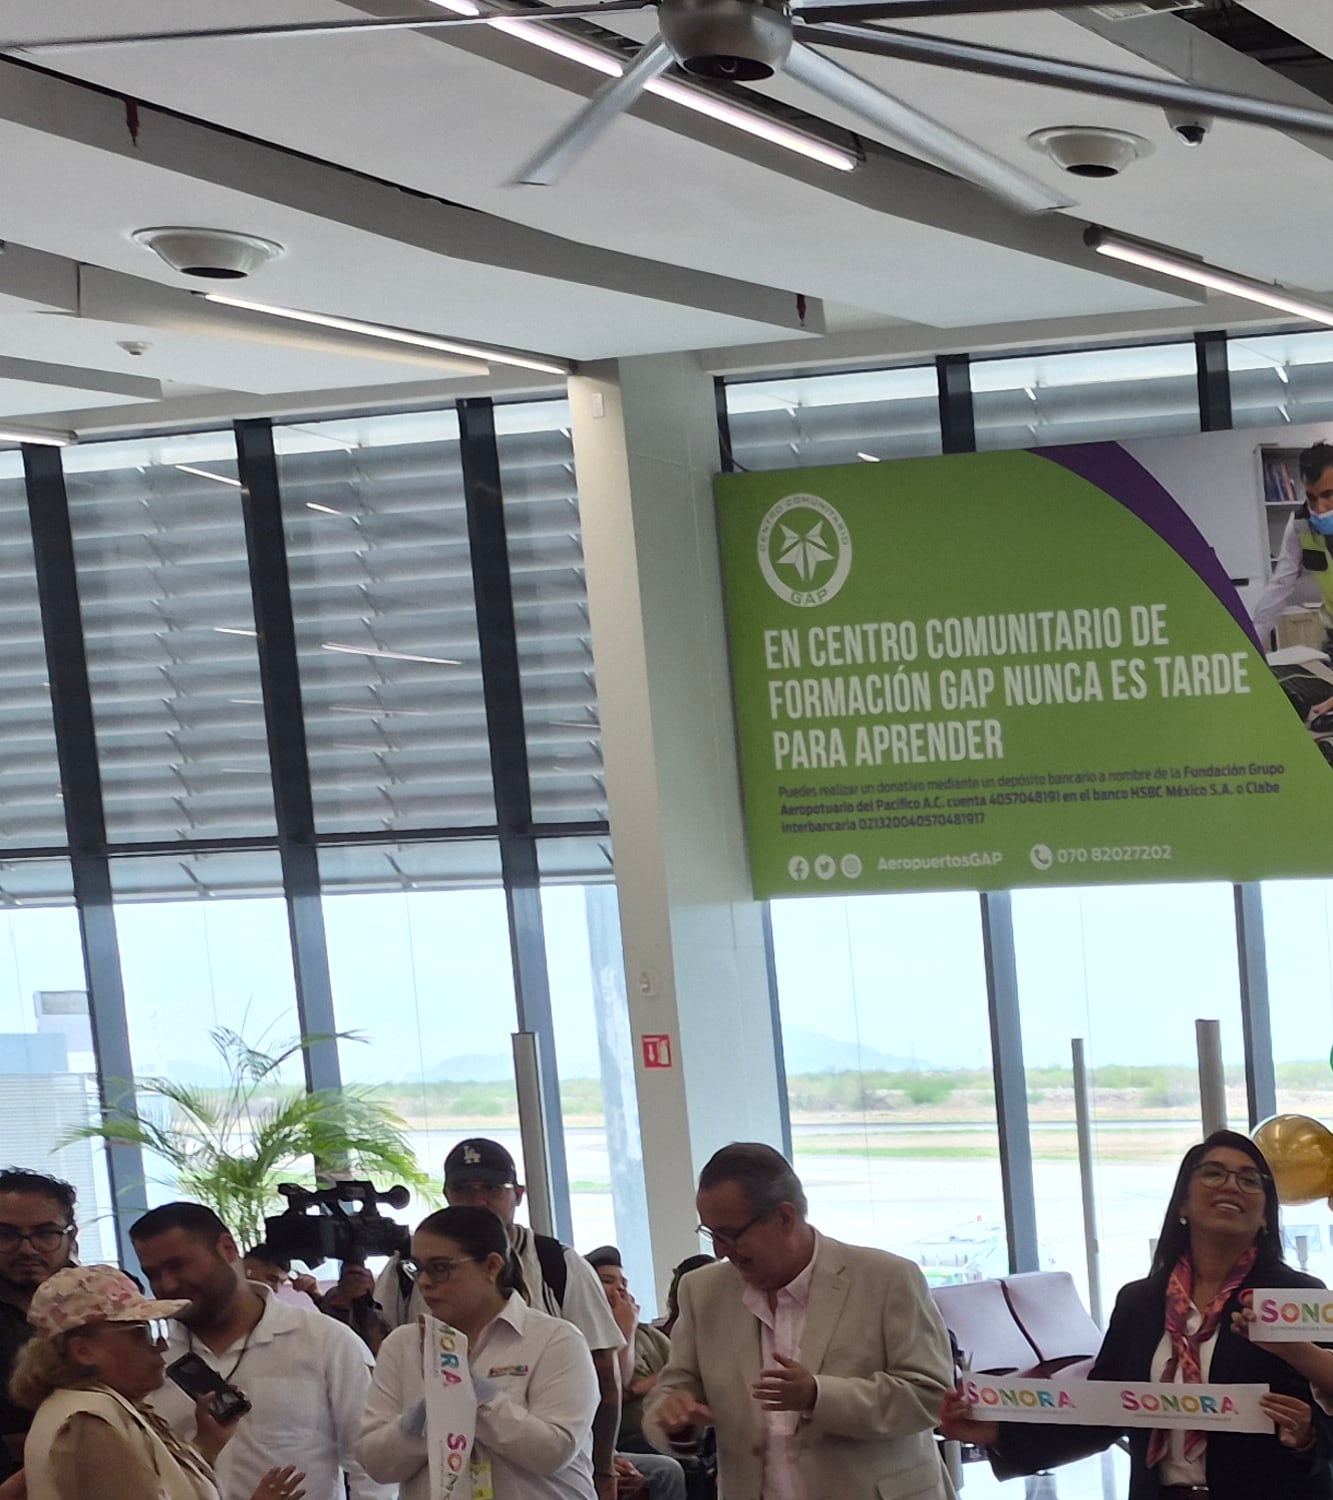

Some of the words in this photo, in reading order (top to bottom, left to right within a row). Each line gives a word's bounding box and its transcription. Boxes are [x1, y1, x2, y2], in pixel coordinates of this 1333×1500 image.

[790, 588, 829, 605] GAP
[763, 628, 801, 669] EN
[808, 620, 918, 668] CENTRO
[926, 606, 1122, 660] COMUNITARIO
[1130, 603, 1170, 647] DE
[768, 664, 932, 720] FORMACIÓN
[939, 667, 995, 711] GAP
[1003, 661, 1104, 707] NUNCA
[1110, 658, 1148, 700] ES
[1153, 652, 1250, 698] TARDE
[773, 727, 847, 770] PARA
[856, 719, 1004, 767] APRENDER
[779, 785, 817, 798] Puedes
[819, 784, 858, 796] realizar
[860, 783, 875, 795] un
[876, 780, 925, 793] donativo
[927, 776, 980, 790] mediante
[982, 777, 996, 788] un
[1047, 771, 1098, 785] bancario
[1108, 768, 1151, 781] nombre
[1154, 767, 1168, 780] de
[1171, 766, 1182, 778] la
[1184, 763, 1246, 778] Fundación
[1249, 762, 1285, 777] Grupo
[856, 800, 874, 812] del
[923, 797, 945, 809] A.C.
[947, 796, 987, 808] cuenta
[1063, 791, 1078, 803] en
[1080, 789, 1090, 802] el
[1092, 788, 1129, 801] banco
[1130, 784, 1164, 800] HSBC
[1166, 782, 1208, 797] México
[1210, 783, 1234, 796] S.A.
[1245, 781, 1281, 795] Clabe
[877, 851, 1004, 873] AeropuertosGAP
[1057, 847, 1088, 863] 070
[1091, 845, 1172, 862] 82027202
[966, 1381, 1077, 1409] SONORA
[1120, 1389, 1240, 1416] SONORA
